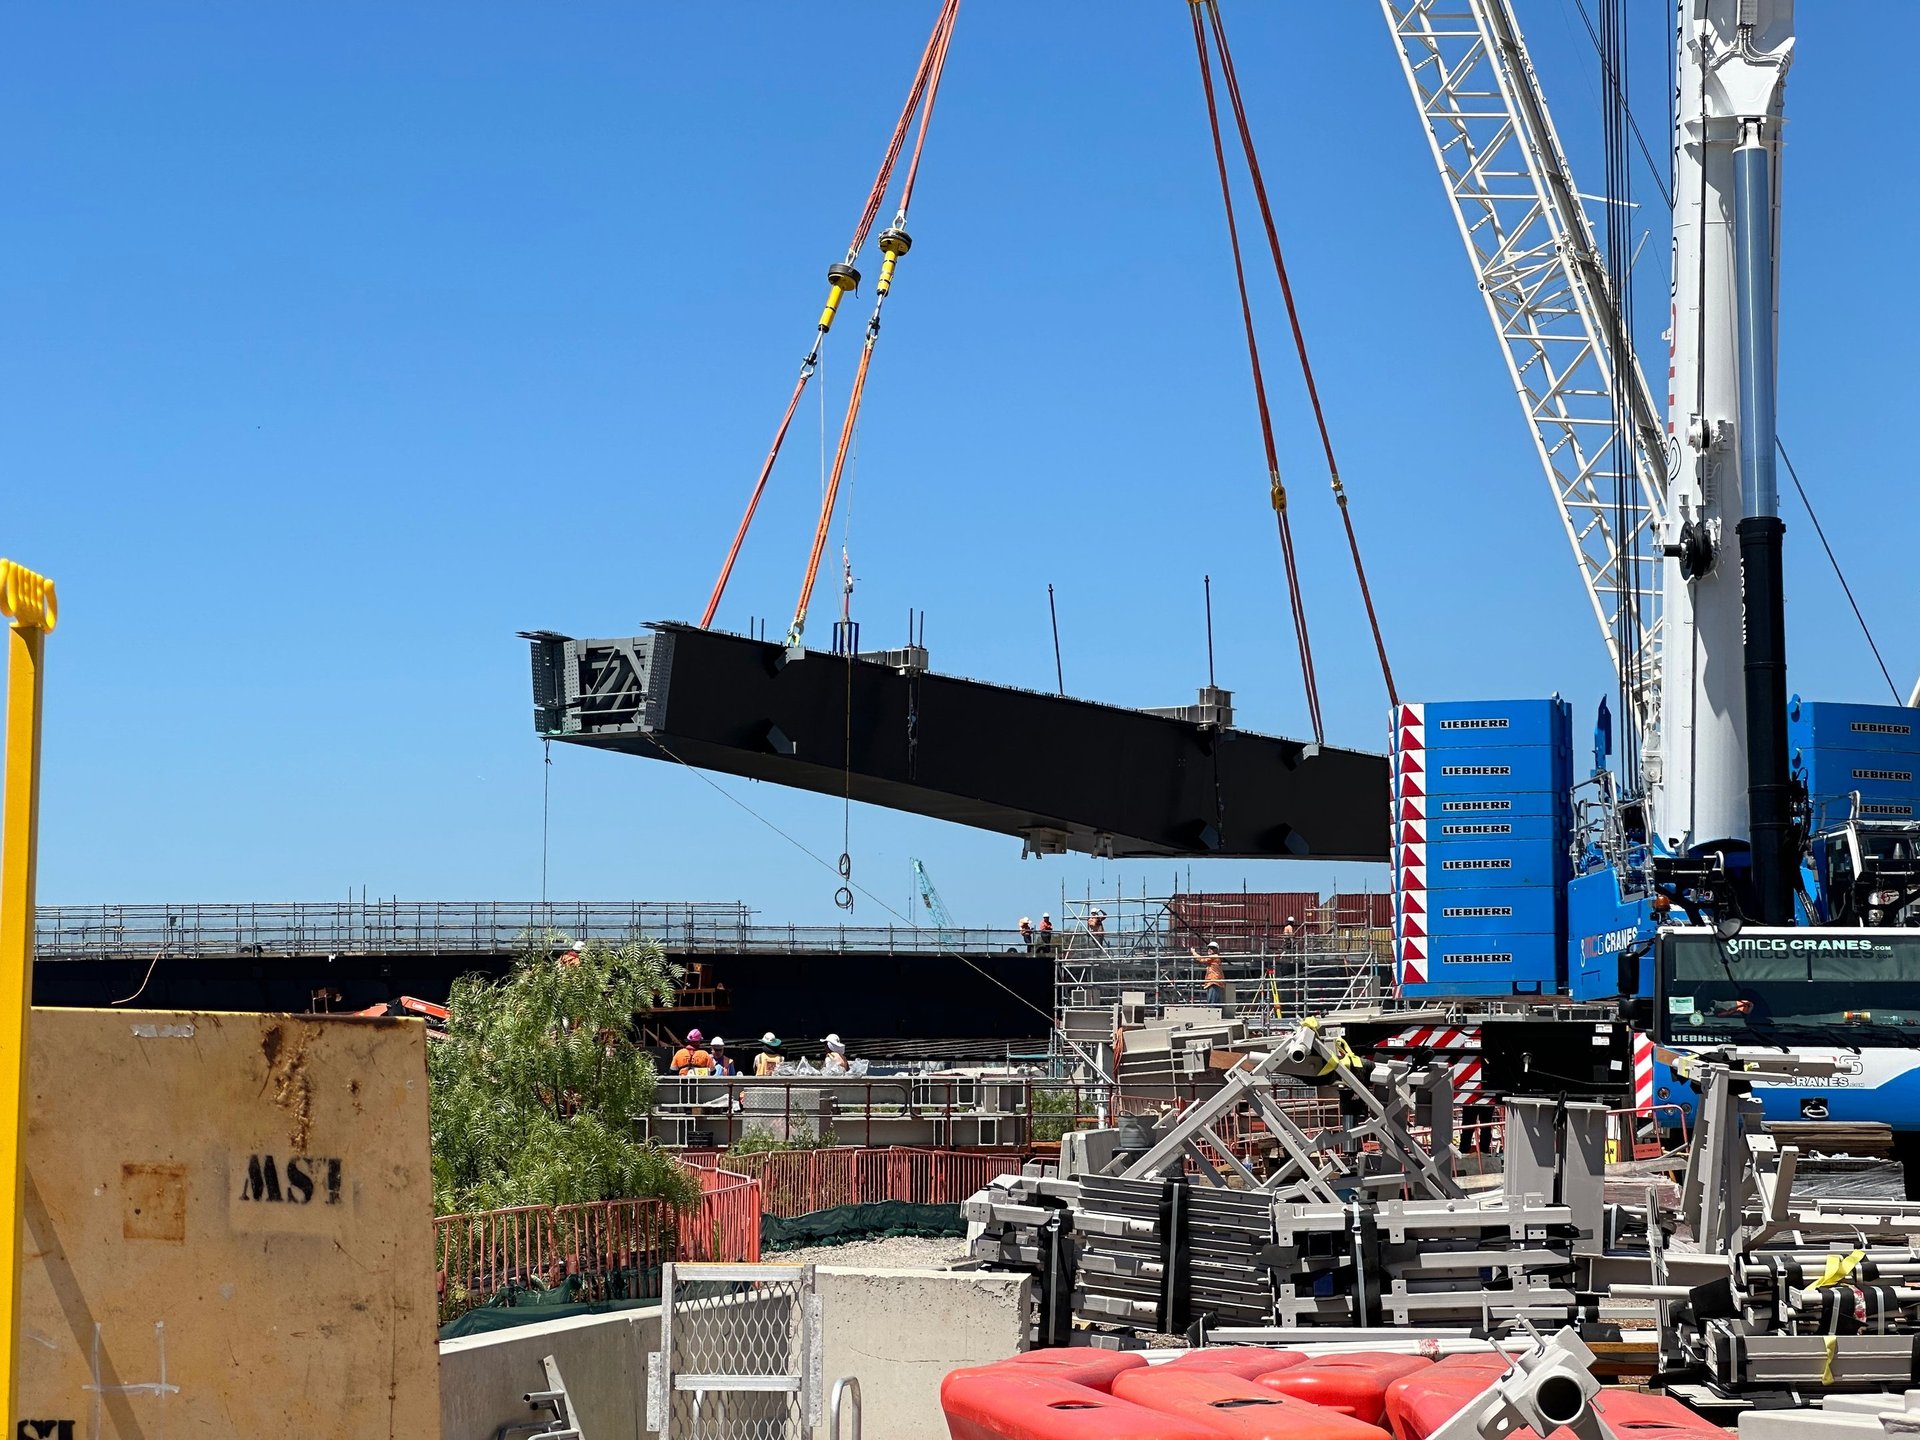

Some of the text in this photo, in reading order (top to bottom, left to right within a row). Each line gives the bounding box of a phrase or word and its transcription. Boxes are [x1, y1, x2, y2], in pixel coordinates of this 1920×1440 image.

[1440, 719, 1508, 729] LIEBHERR
[1851, 723, 1910, 734] LIEBHERR
[1442, 766, 1510, 775] LIEBHERR
[1852, 770, 1911, 780] LIEBHERR
[1443, 801, 1510, 811] LIEBHERR
[1860, 805, 1912, 814] IEBHERR
[1443, 825, 1510, 834] LIEBHERR
[1443, 860, 1510, 870] LIEBHERR
[1443, 907, 1511, 917] LIEBHERR
[1443, 953, 1511, 963] LIEBHERR
[1671, 1034, 1732, 1043] LIEBHERR
